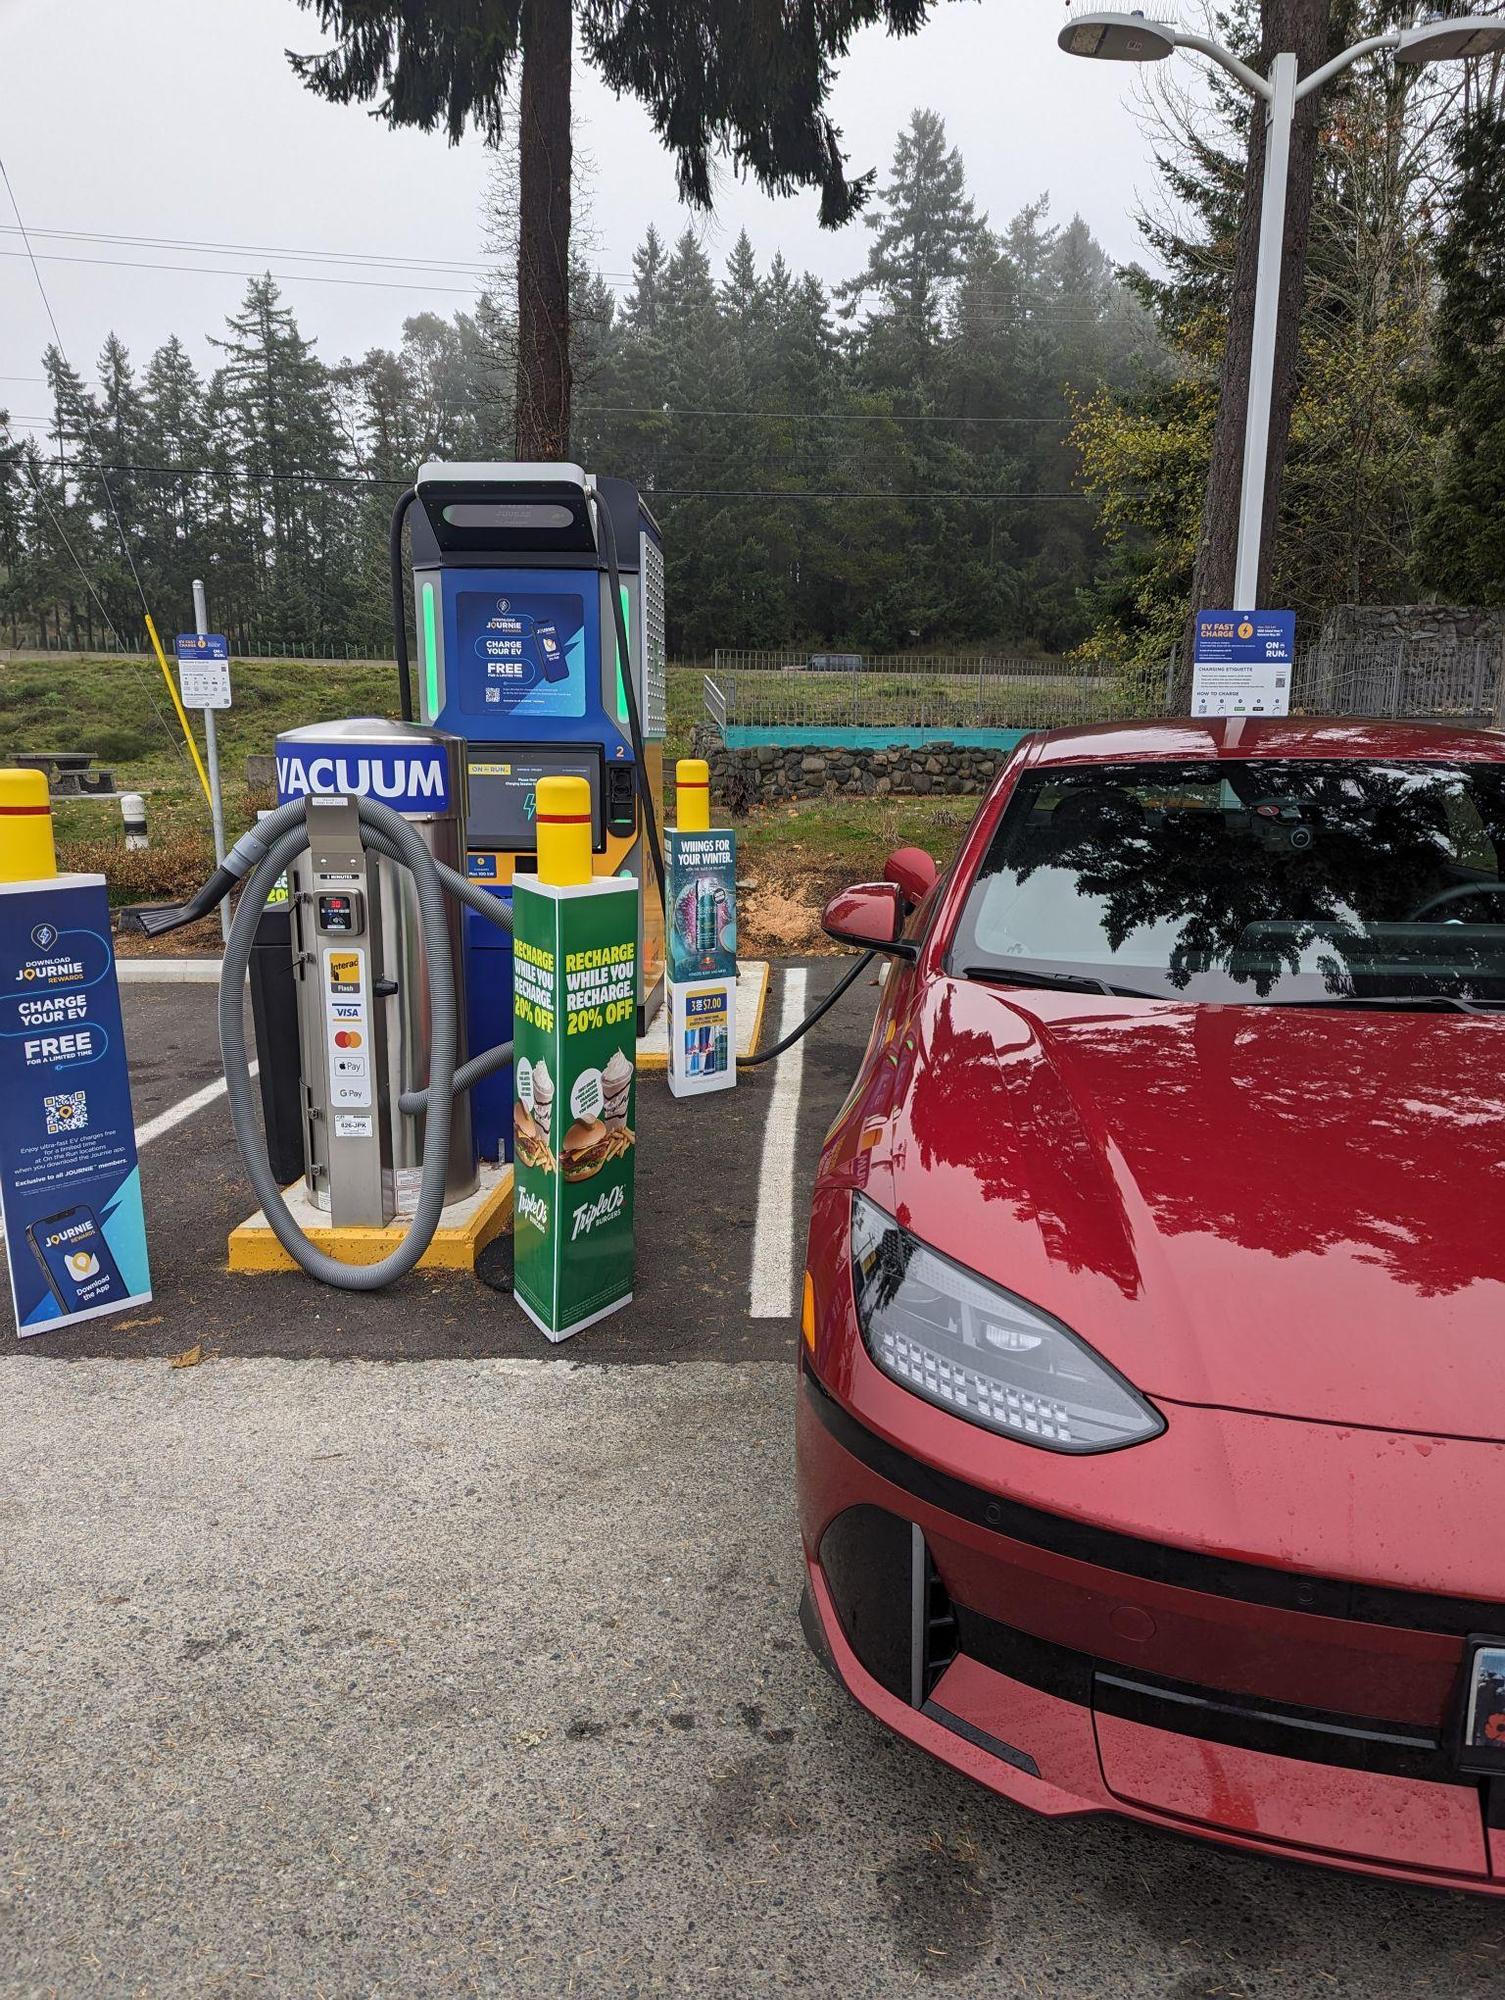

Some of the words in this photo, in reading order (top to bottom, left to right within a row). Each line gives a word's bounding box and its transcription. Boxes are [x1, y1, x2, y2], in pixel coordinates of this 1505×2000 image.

[486, 621, 522, 629] JOURNIE
[488, 663, 522, 674] FREE
[616, 746, 624, 757] 2
[276, 756, 444, 798] VACUUM
[715, 840, 730, 851] FOR
[678, 854, 700, 865] YOUR
[702, 852, 733, 865] WINTER.
[267, 888, 288, 902] 20
[26, 956, 71, 968] DOWNLOAD
[514, 938, 554, 972] RECHARGE
[566, 942, 634, 973] RECHARGE
[16, 962, 83, 981] JOURNIE
[331, 960, 358, 970] Interac
[514, 956, 536, 982] WHILE
[536, 967, 554, 991] YOU
[48, 974, 84, 983] REWARDS
[566, 966, 608, 991] WHILE
[610, 961, 634, 982] YOU
[18, 995, 86, 1014] CHARGE
[566, 980, 634, 1012] RECHARGE.
[21, 1010, 64, 1026] YOUR
[68, 1007, 87, 1019] EV
[336, 1008, 358, 1017] VISA
[515, 994, 532, 1024] 20%
[534, 1006, 554, 1034] OFF
[567, 1007, 603, 1035] 20%
[606, 998, 633, 1025] OFF
[24, 1032, 92, 1059] FREE
[27, 1057, 41, 1066] FOR
[49, 1052, 76, 1062] LIMITED
[347, 1062, 360, 1072] Pay
[340, 1089, 347, 1097] G
[349, 1090, 362, 1100] Pay
[20, 1146, 39, 1154] Enjoy
[40, 1140, 68, 1150] ultra-fast
[80, 1133, 103, 1142] charges
[80, 1145, 106, 1155] locations
[14, 1166, 32, 1174] when
[33, 1164, 45, 1172] you
[47, 1157, 78, 1168] download
[90, 1149, 112, 1159] Journie
[15, 1176, 46, 1187] Exclusive
[98, 1158, 128, 1169] members.
[596, 1208, 621, 1227] BURGERS
[45, 1220, 93, 1247] JOURNIE
[76, 1274, 110, 1296] Download
[83, 1292, 95, 1300] the
[96, 1284, 110, 1294] App
